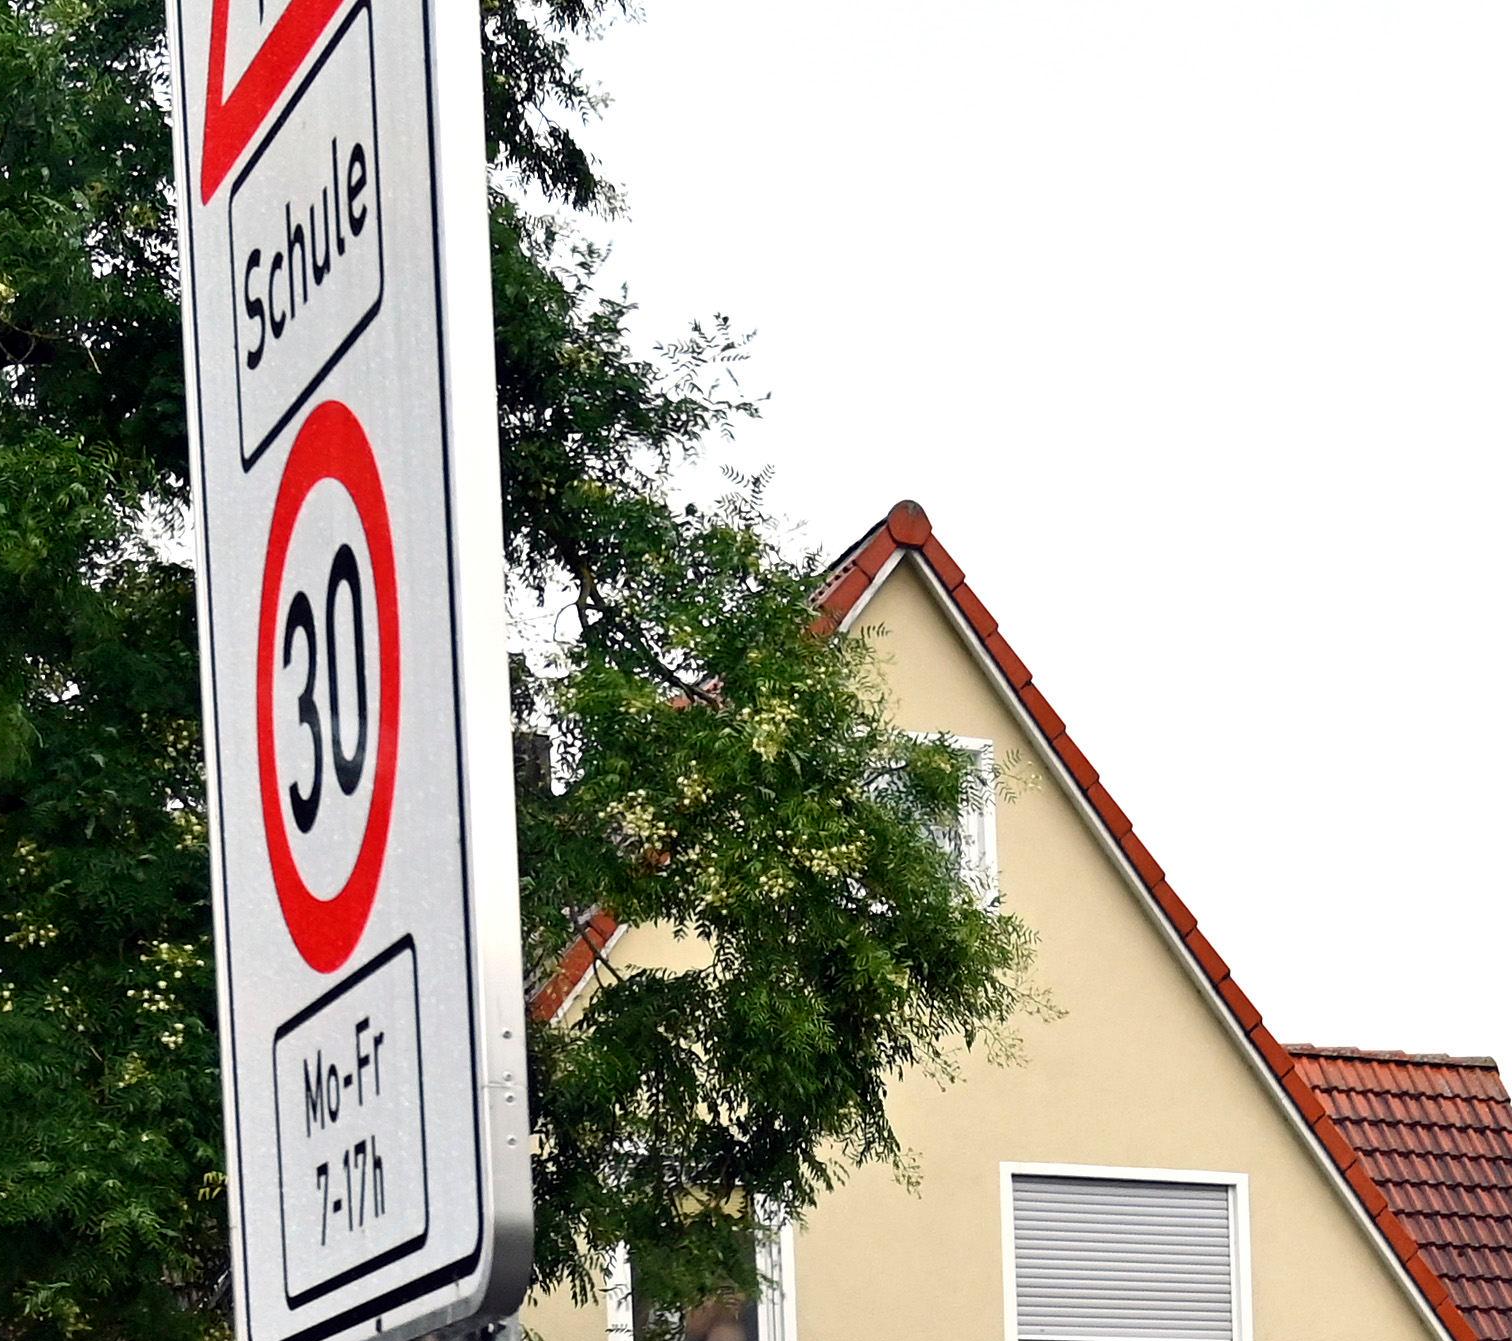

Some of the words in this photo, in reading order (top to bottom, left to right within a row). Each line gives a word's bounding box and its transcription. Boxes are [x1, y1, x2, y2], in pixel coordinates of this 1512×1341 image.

[244, 136, 368, 370] Schule
[283, 543, 367, 834] 30
[303, 1016, 385, 1138] Mo-Fr
[316, 1134, 386, 1247] 7-17h
